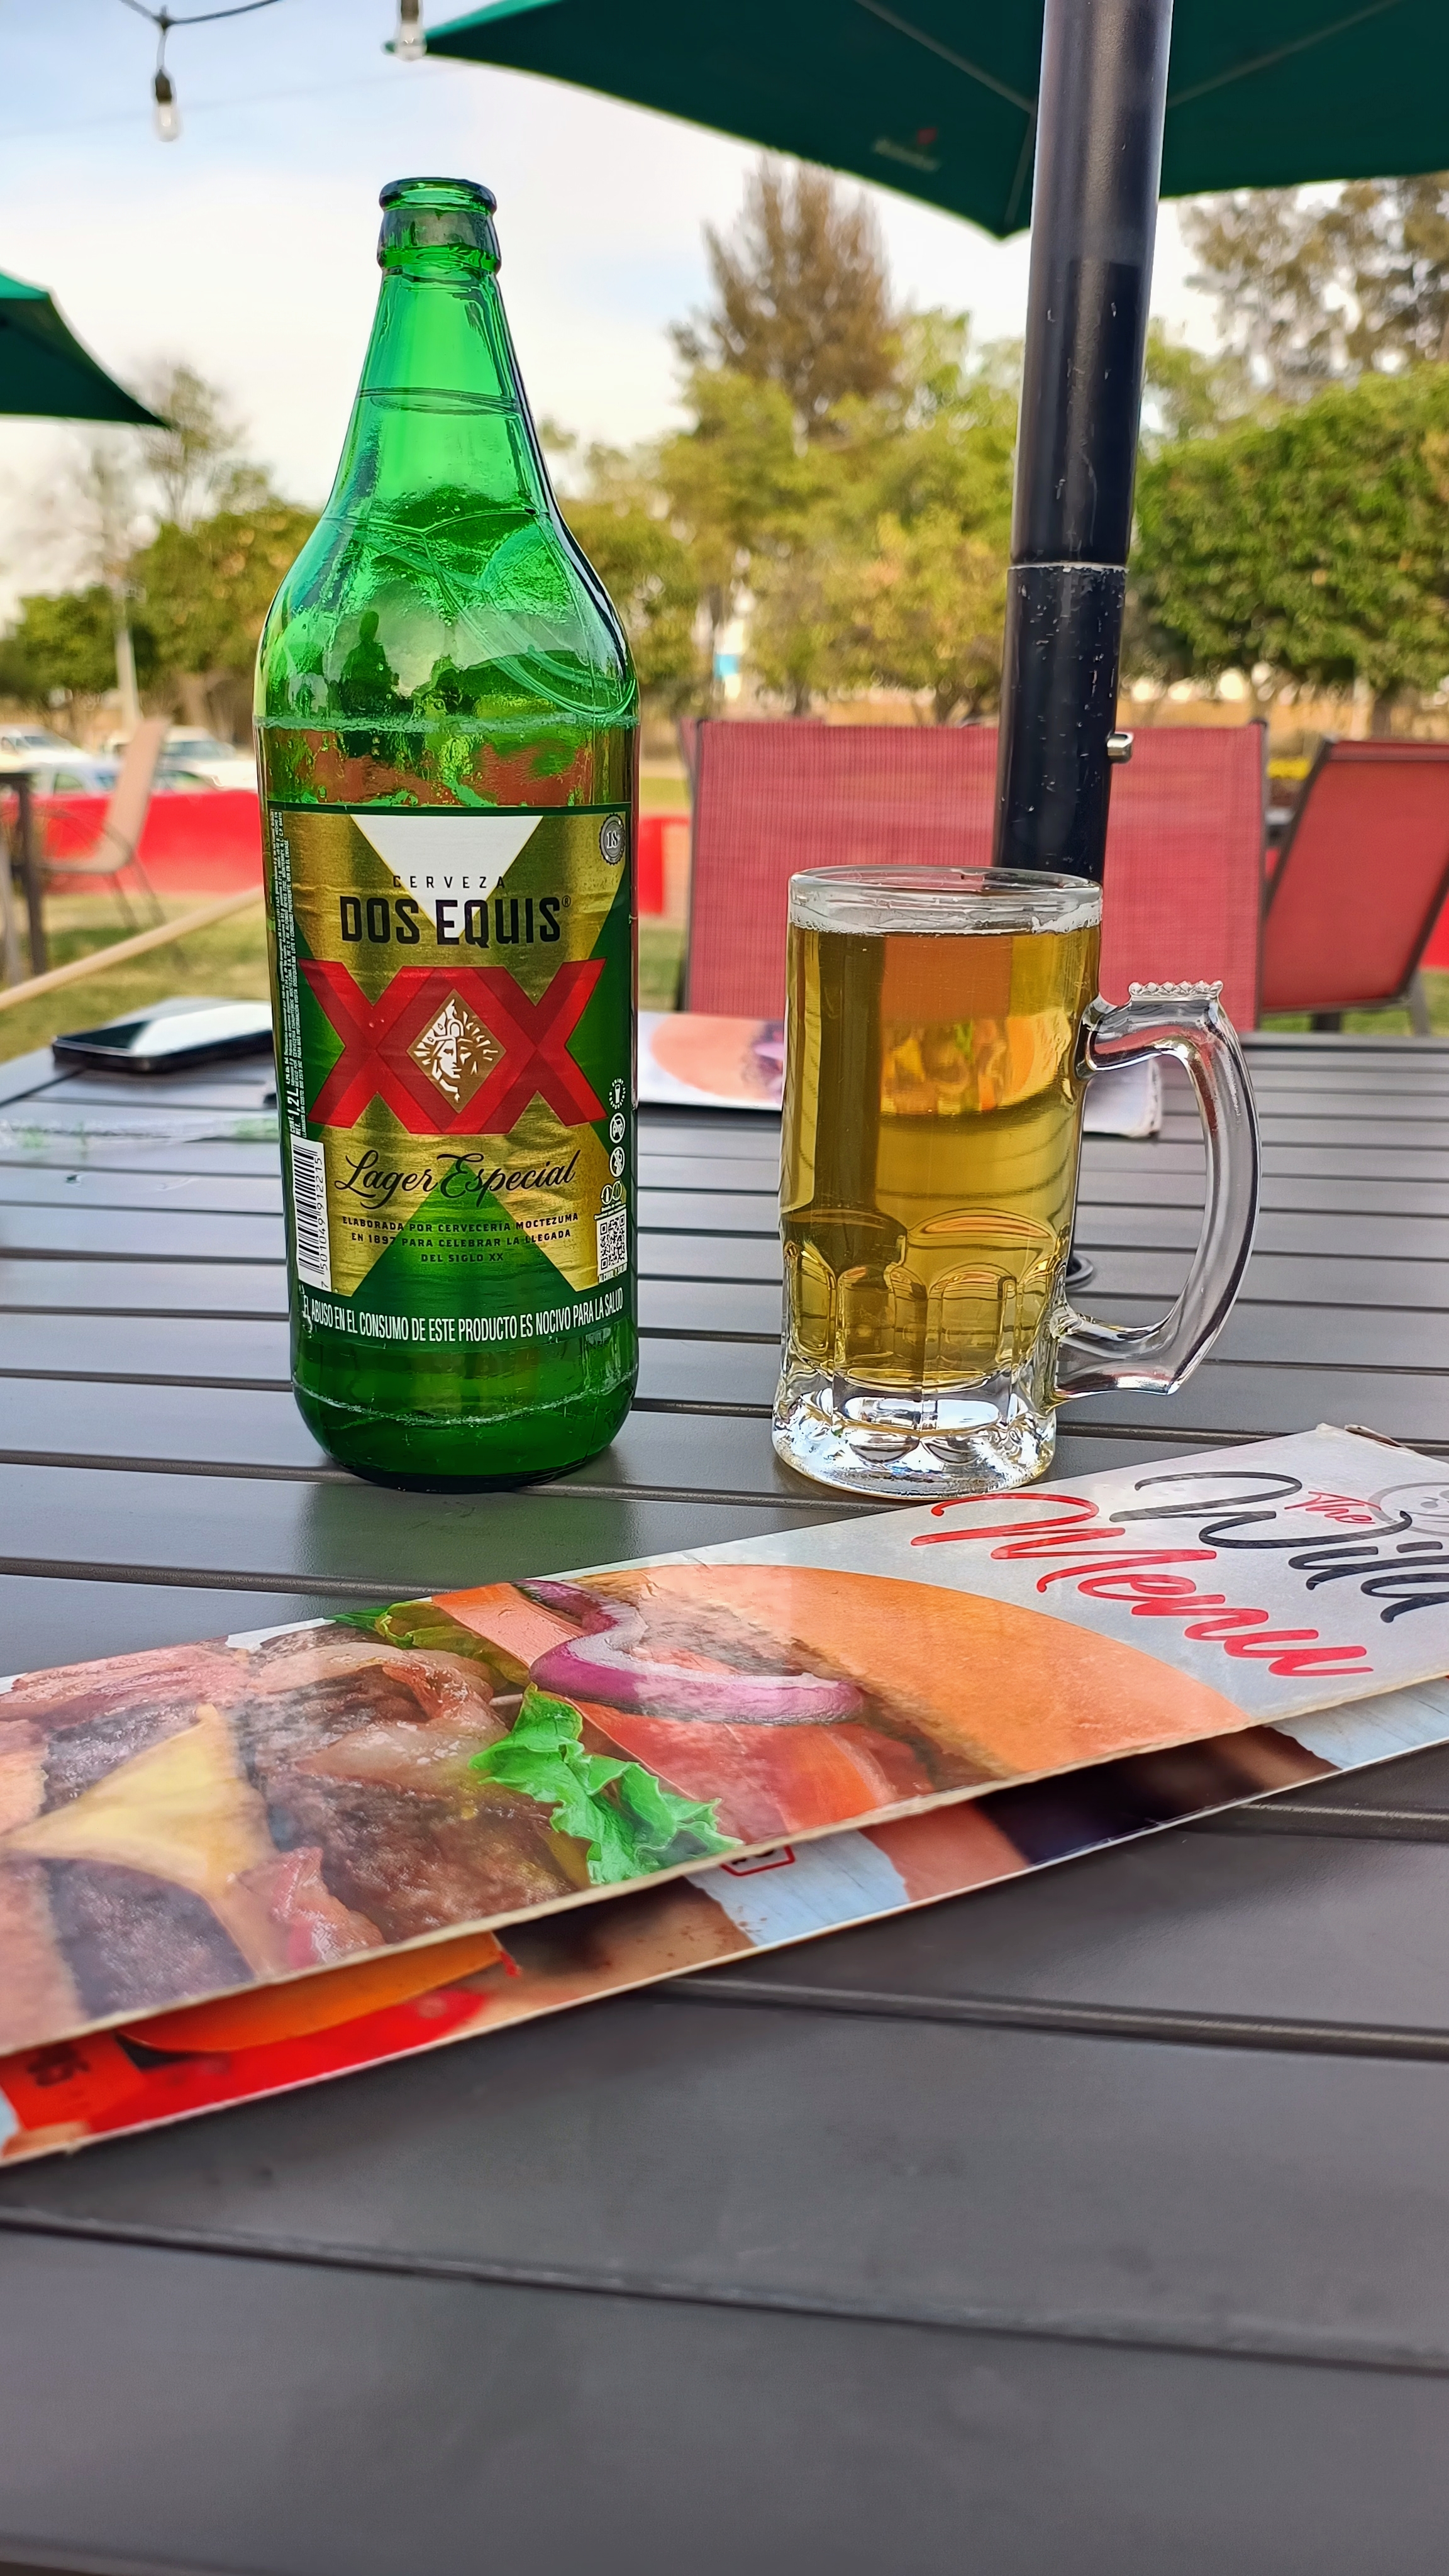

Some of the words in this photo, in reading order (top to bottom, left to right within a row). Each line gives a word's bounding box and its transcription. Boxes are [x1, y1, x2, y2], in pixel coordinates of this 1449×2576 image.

[392, 876, 505, 889] CERVEZA
[340, 896, 420, 945] DOS
[297, 957, 608, 1135] XX
[335, 1150, 440, 1209] Lager
[436, 1149, 581, 1208] Especial
[342, 1216, 404, 1231] ELABORADA
[409, 1223, 433, 1232] POR
[438, 1220, 511, 1233] CERVECERÍA
[516, 1213, 579, 1230] MOCTEZUMA
[352, 1233, 364, 1241] EN
[369, 1235, 396, 1245] 1897
[402, 1238, 433, 1247] PARA
[439, 1238, 501, 1248] CELEBRAR
[507, 1237, 519, 1245] LA
[525, 1229, 571, 1244] LLEGADA
[421, 1253, 443, 1263] DEL
[448, 1253, 484, 1263] SIGLO
[489, 1253, 504, 1262] XX
[311, 1299, 333, 1328] ABUSO
[335, 1306, 346, 1331] EN
[347, 1309, 358, 1334] EL
[359, 1311, 409, 1341] CONSUMO
[411, 1318, 426, 1341] DE
[429, 1318, 456, 1342] ESTE
[458, 1315, 518, 1342] PRODUCTO
[520, 1313, 533, 1338] ES
[536, 1306, 571, 1336] NOCIVO
[573, 1300, 594, 1328] PARA
[595, 1296, 604, 1321] LA
[604, 1287, 623, 1318] SALUD
[1284, 1491, 1382, 1524] The
[910, 1492, 1374, 1677] Menu
